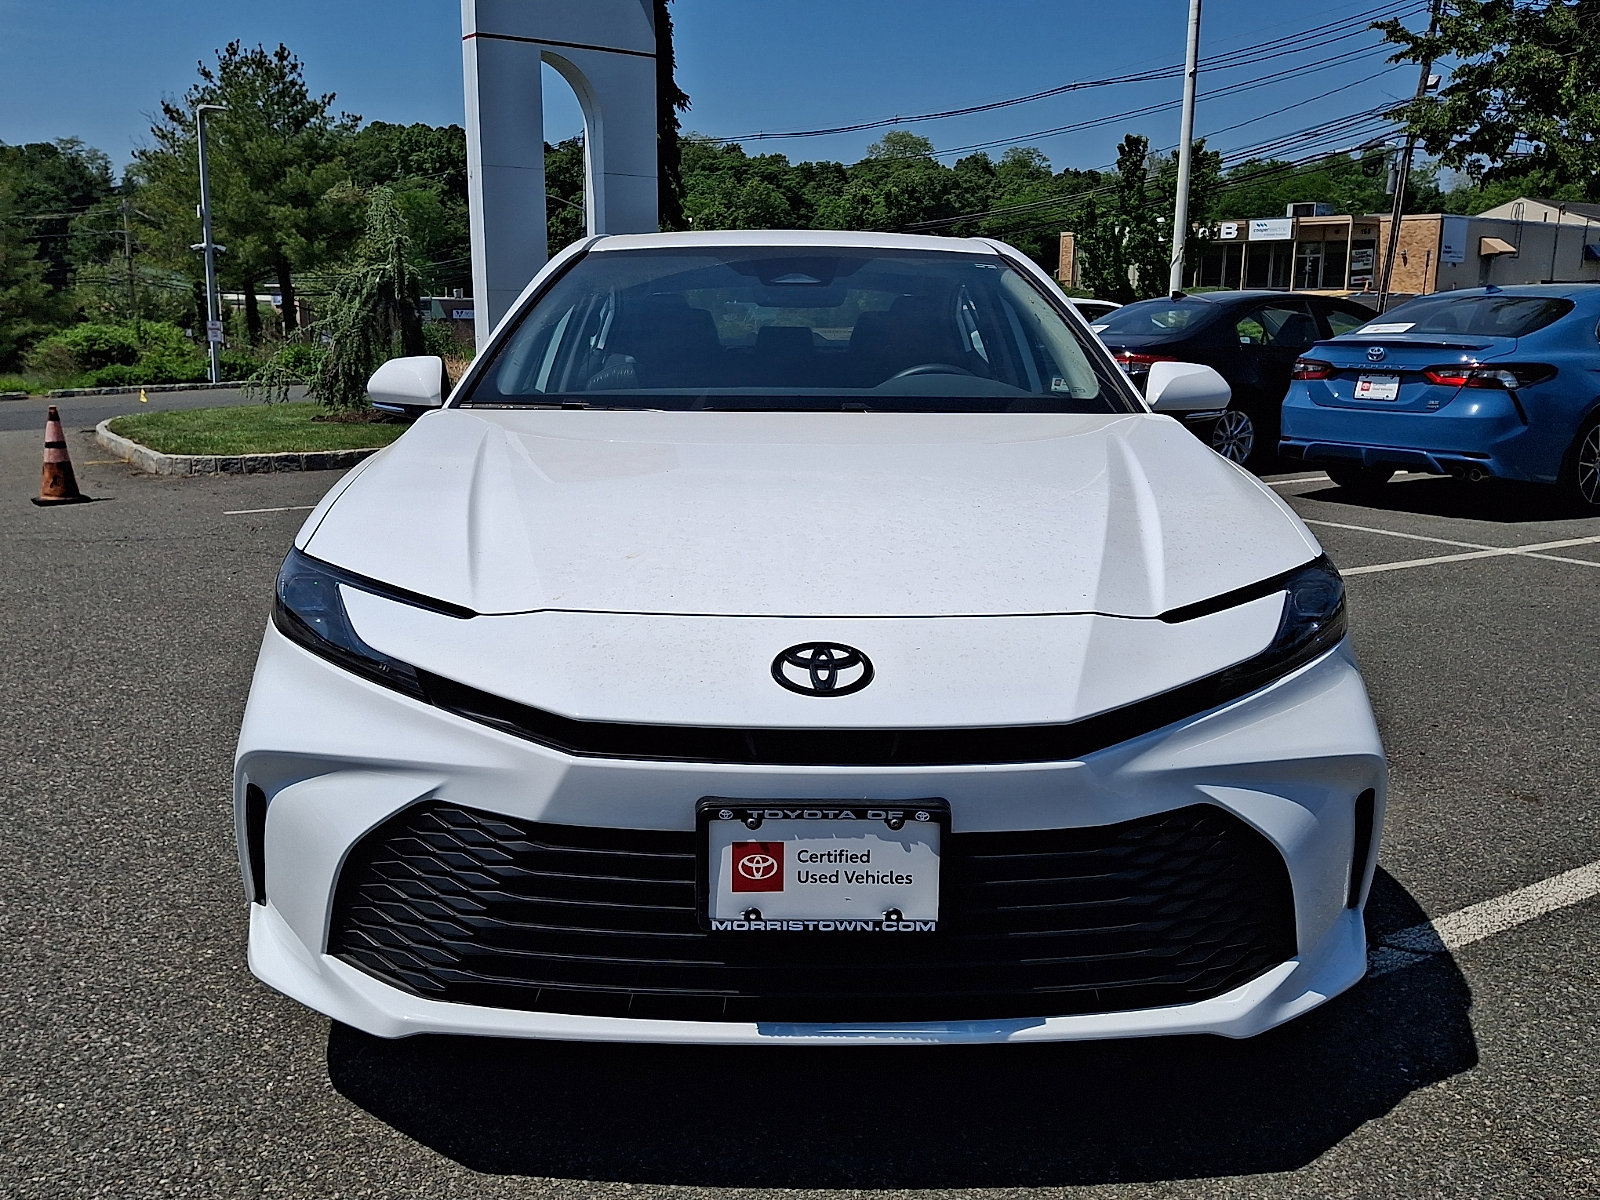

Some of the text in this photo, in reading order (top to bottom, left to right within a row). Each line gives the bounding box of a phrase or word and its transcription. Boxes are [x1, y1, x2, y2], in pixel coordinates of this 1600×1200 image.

[746, 810, 904, 820] TOYOTA OF
[797, 849, 871, 864] Certified
[797, 870, 913, 885] Used Vehicles
[711, 920, 936, 932] MORRISTOWN.COM
